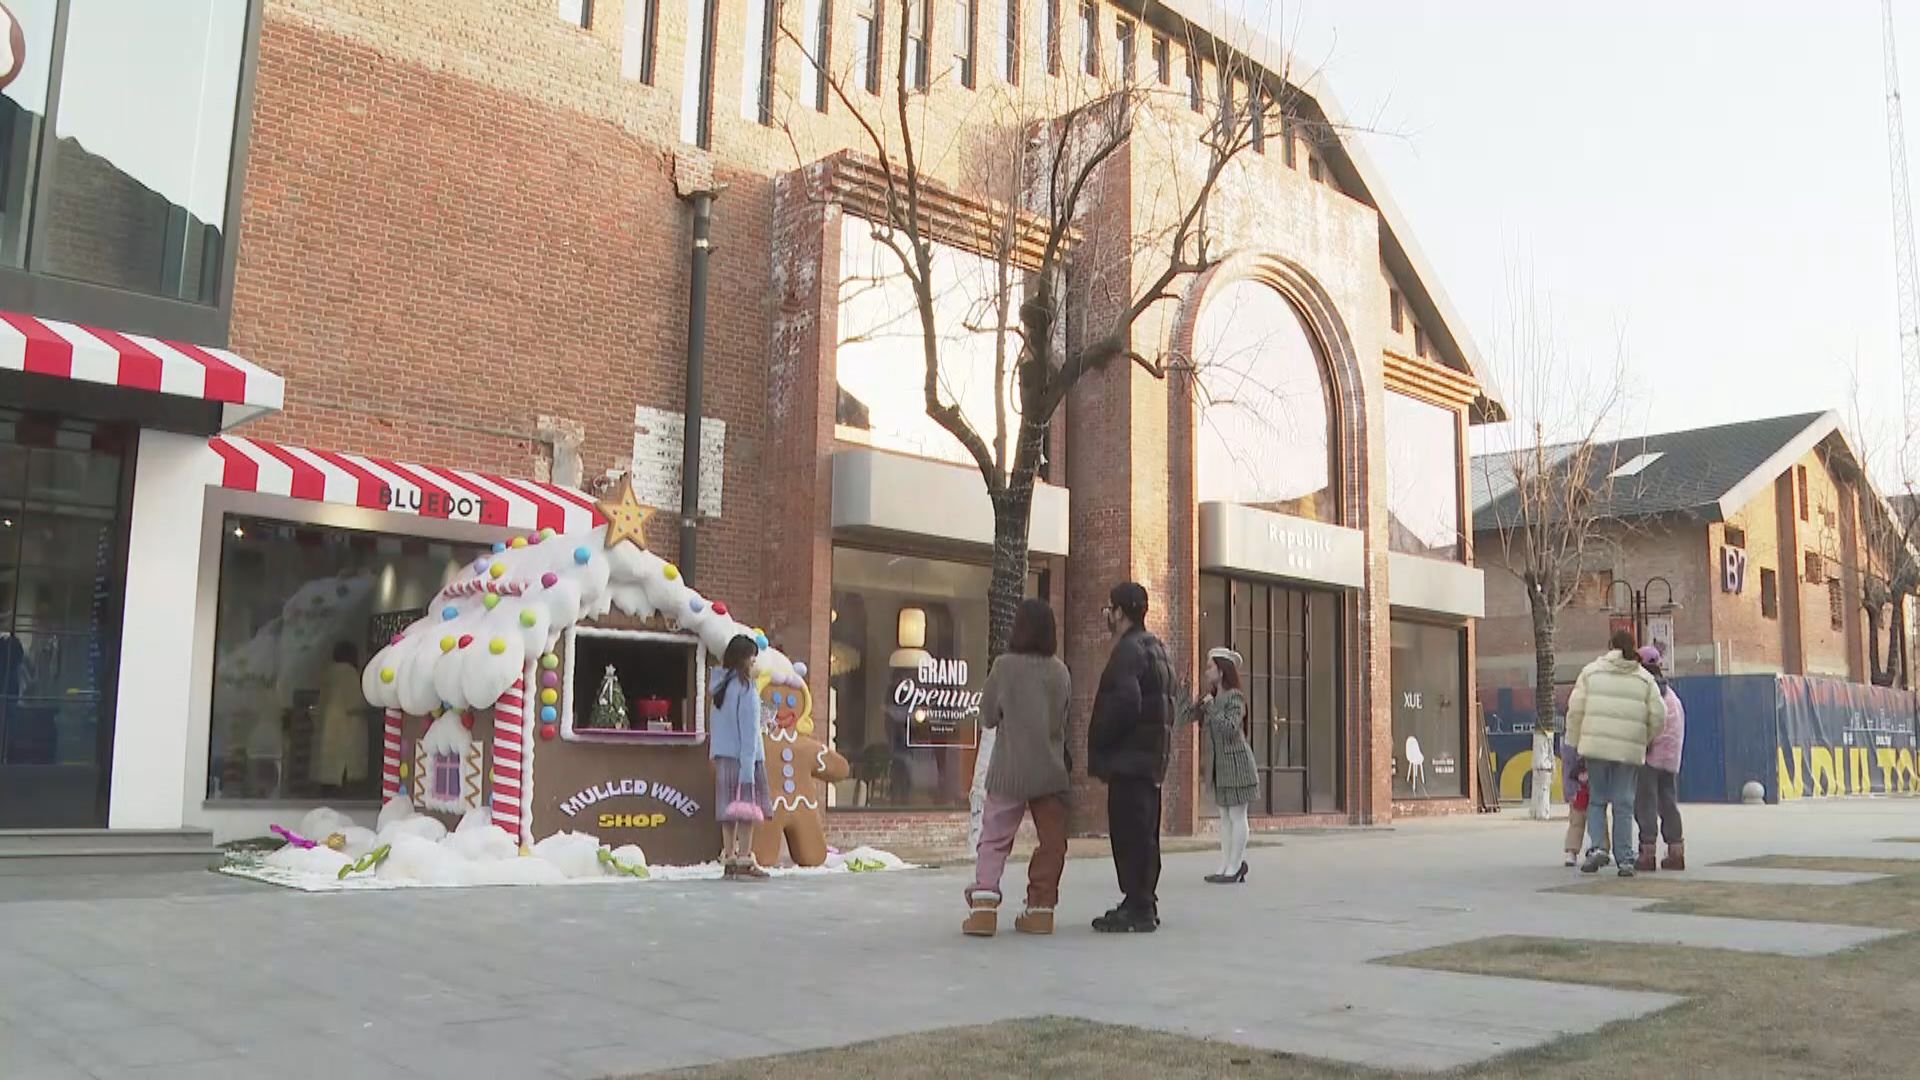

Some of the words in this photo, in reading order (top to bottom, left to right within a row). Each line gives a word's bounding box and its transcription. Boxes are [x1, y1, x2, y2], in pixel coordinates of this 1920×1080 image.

[1269, 522, 1332, 552] Republic
[1723, 546, 1747, 594] B7
[918, 657, 968, 685] GRAND
[894, 678, 984, 717] Opening
[1403, 692, 1423, 709] XUE
[921, 709, 965, 720] NVITATION
[559, 779, 648, 817] MULLED
[650, 781, 700, 818] WINE
[598, 813, 667, 828] SHOP
